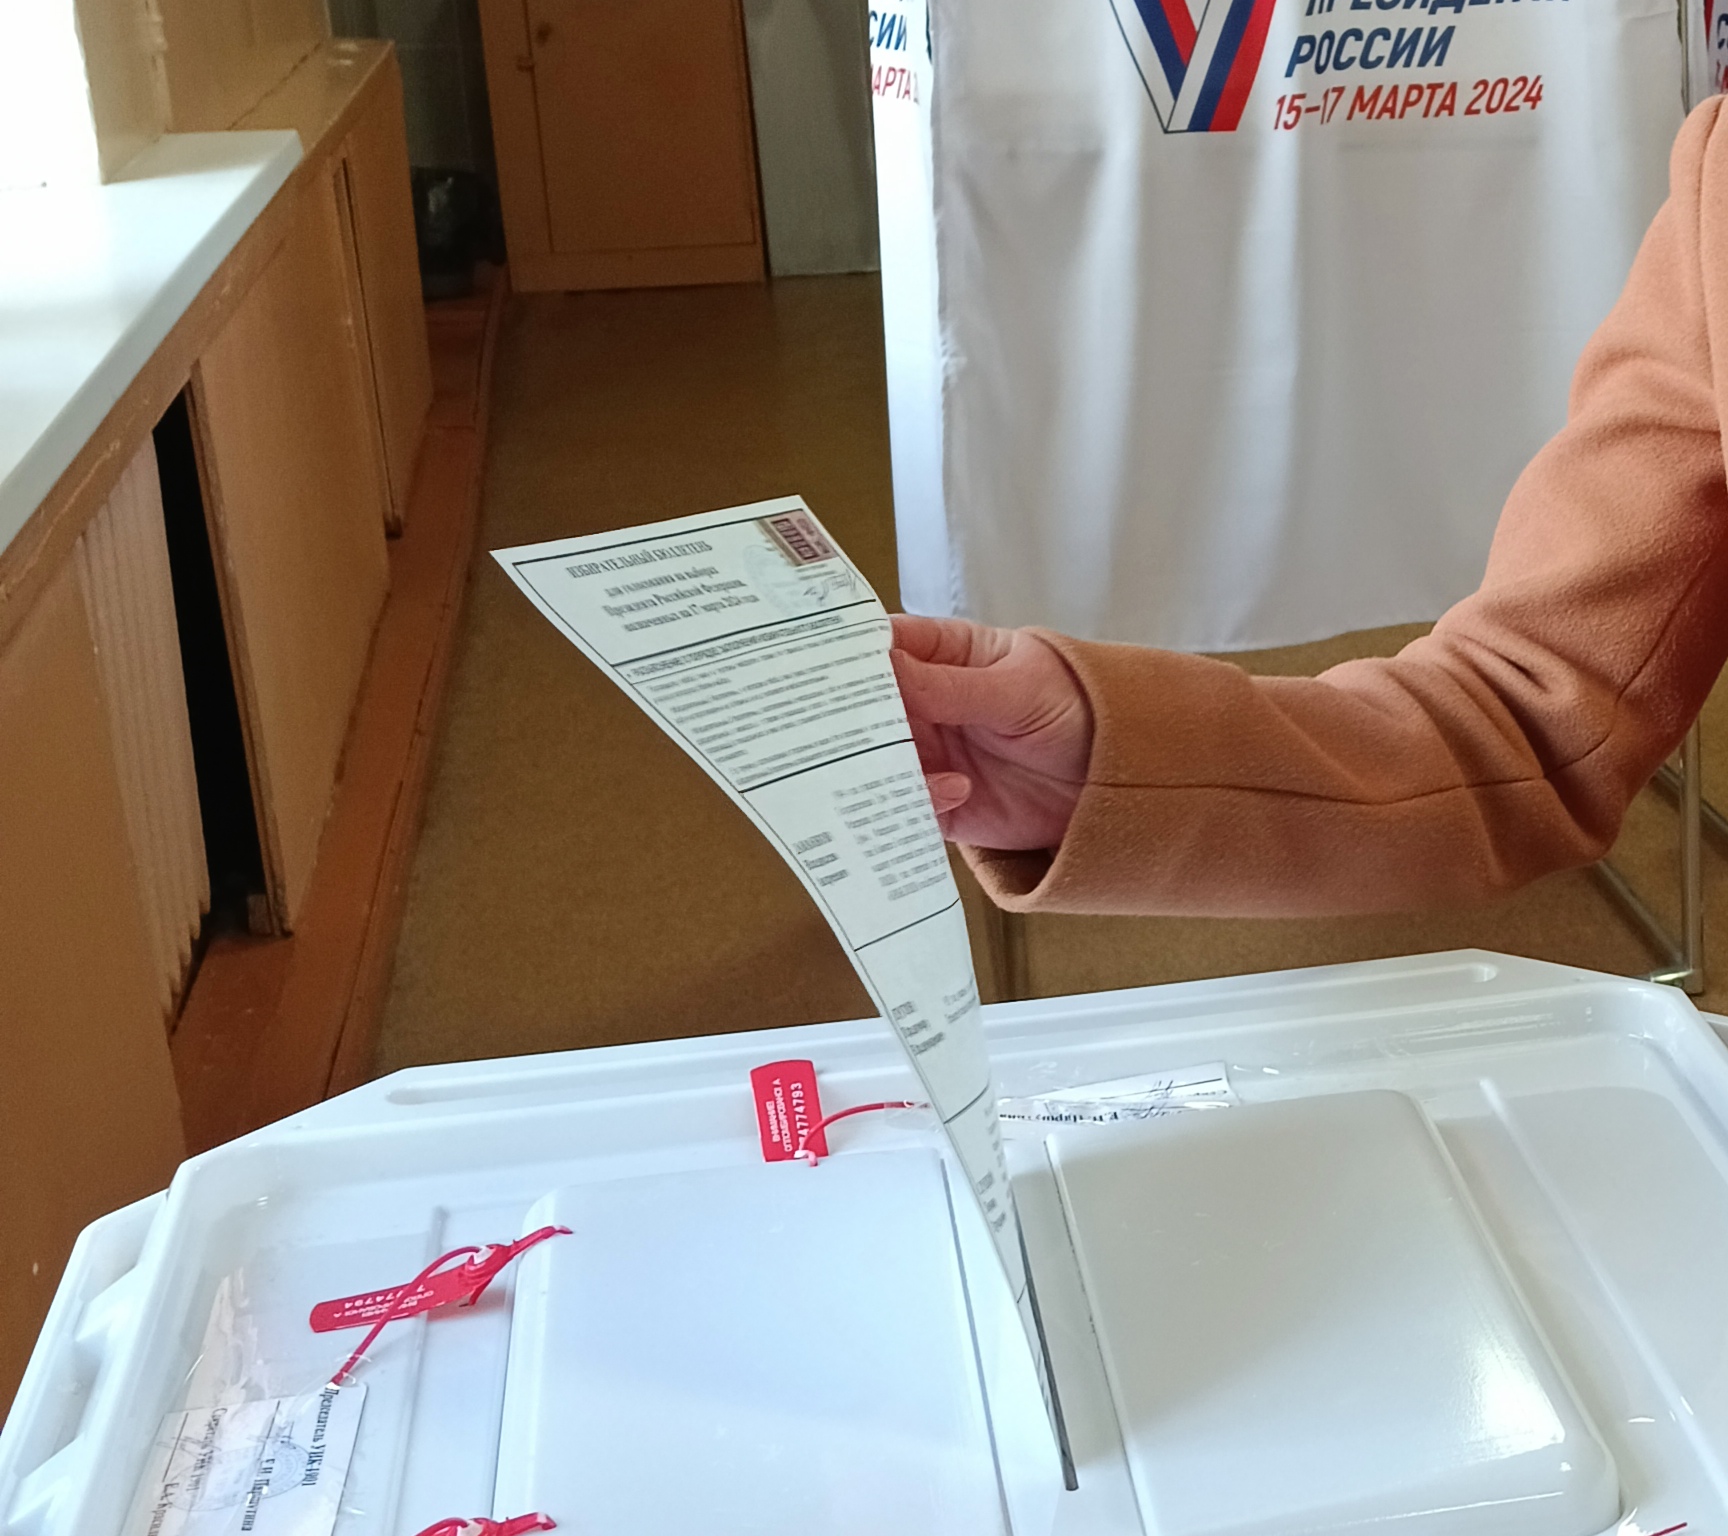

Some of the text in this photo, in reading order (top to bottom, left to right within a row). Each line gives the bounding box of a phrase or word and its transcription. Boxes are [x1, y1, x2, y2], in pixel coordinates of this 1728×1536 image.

[1285, 25, 1456, 78] РОССИИ
[871, 65, 912, 101] АРТА
[1347, 82, 1458, 121] МАРТА
[1464, 75, 1543, 118] 2024
[312, 1387, 341, 1443] Председатель
